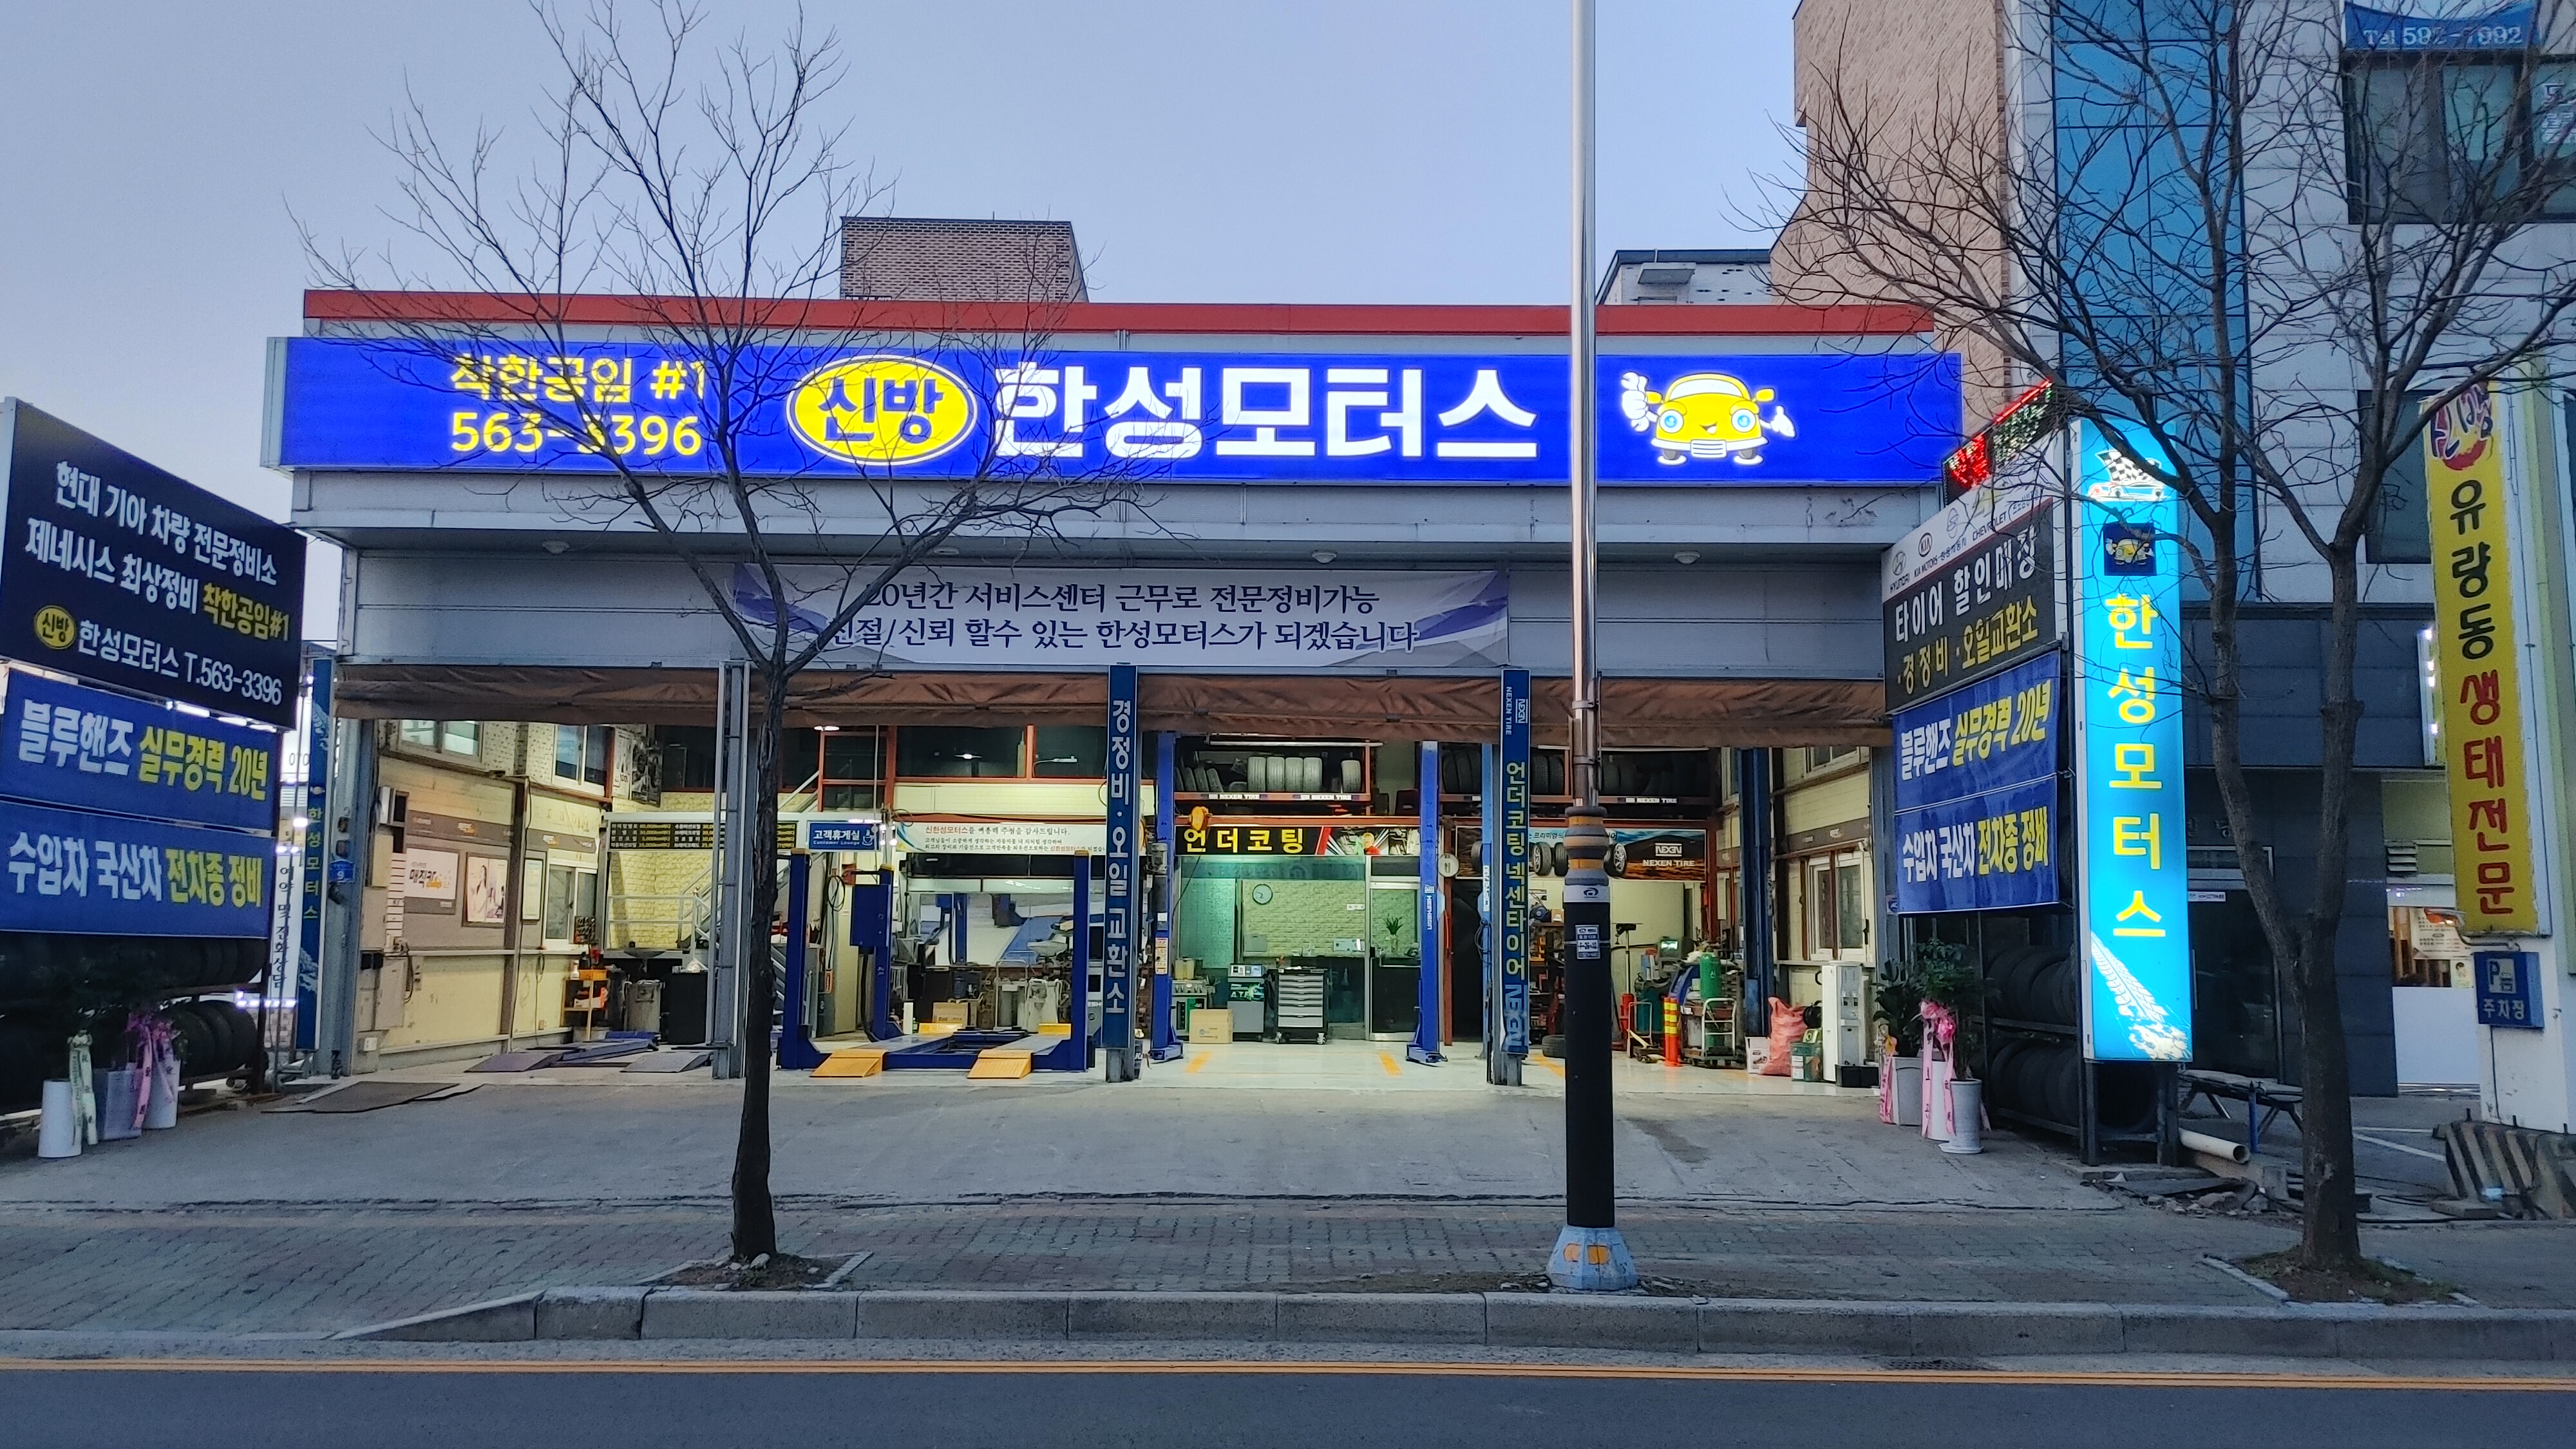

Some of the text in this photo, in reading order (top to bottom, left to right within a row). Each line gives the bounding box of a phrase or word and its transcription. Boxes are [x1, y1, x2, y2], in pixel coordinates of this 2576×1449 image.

[451, 353, 706, 402] 착한공임 #1
[818, 361, 1539, 459] 신방 한성모터스
[56, 460, 278, 587] 현대 기아 차량 전문정비소
[1920, 542, 1931, 554] KIA
[1972, 511, 2007, 541] CHEVROLET
[25, 517, 289, 641] 제네시스 최상정비 착한공임#1
[865, 581, 1380, 615] 20년간 서비스센터 근무로 전문정비가능
[964, 618, 1023, 647] 할수
[1032, 619, 1089, 649] 있는
[1095, 620, 1267, 650] 한성모터스가
[1274, 620, 1419, 652] 되겠습니다
[1895, 580, 1943, 643] 타이어
[41, 610, 283, 706] 신방 한성모터스 T.563-3396
[1515, 699, 1528, 723] NEXEN
[1900, 679, 2051, 781] 블루핸즈 실무경력 20년
[19, 699, 269, 801] 블루핸즈 실무경력 20년
[2105, 593, 2166, 937] 한성모터스
[813, 829, 860, 841] 고객휴게실
[925, 826, 975, 835] 신한성모터스를
[1025, 827, 1070, 836] 감사드립니다.
[1184, 828, 1303, 854] 언더코팅
[1655, 844, 1682, 856] NEXEN
[1902, 806, 2049, 883] 수입차 국산차 전차종 정비
[8, 832, 262, 908] 수입차 국산차 전차종 정비
[303, 807, 322, 919] 한성모터스
[1504, 762, 1527, 981] 언더코팅 넥센타이어
[2483, 998, 2524, 1020] 주차장
